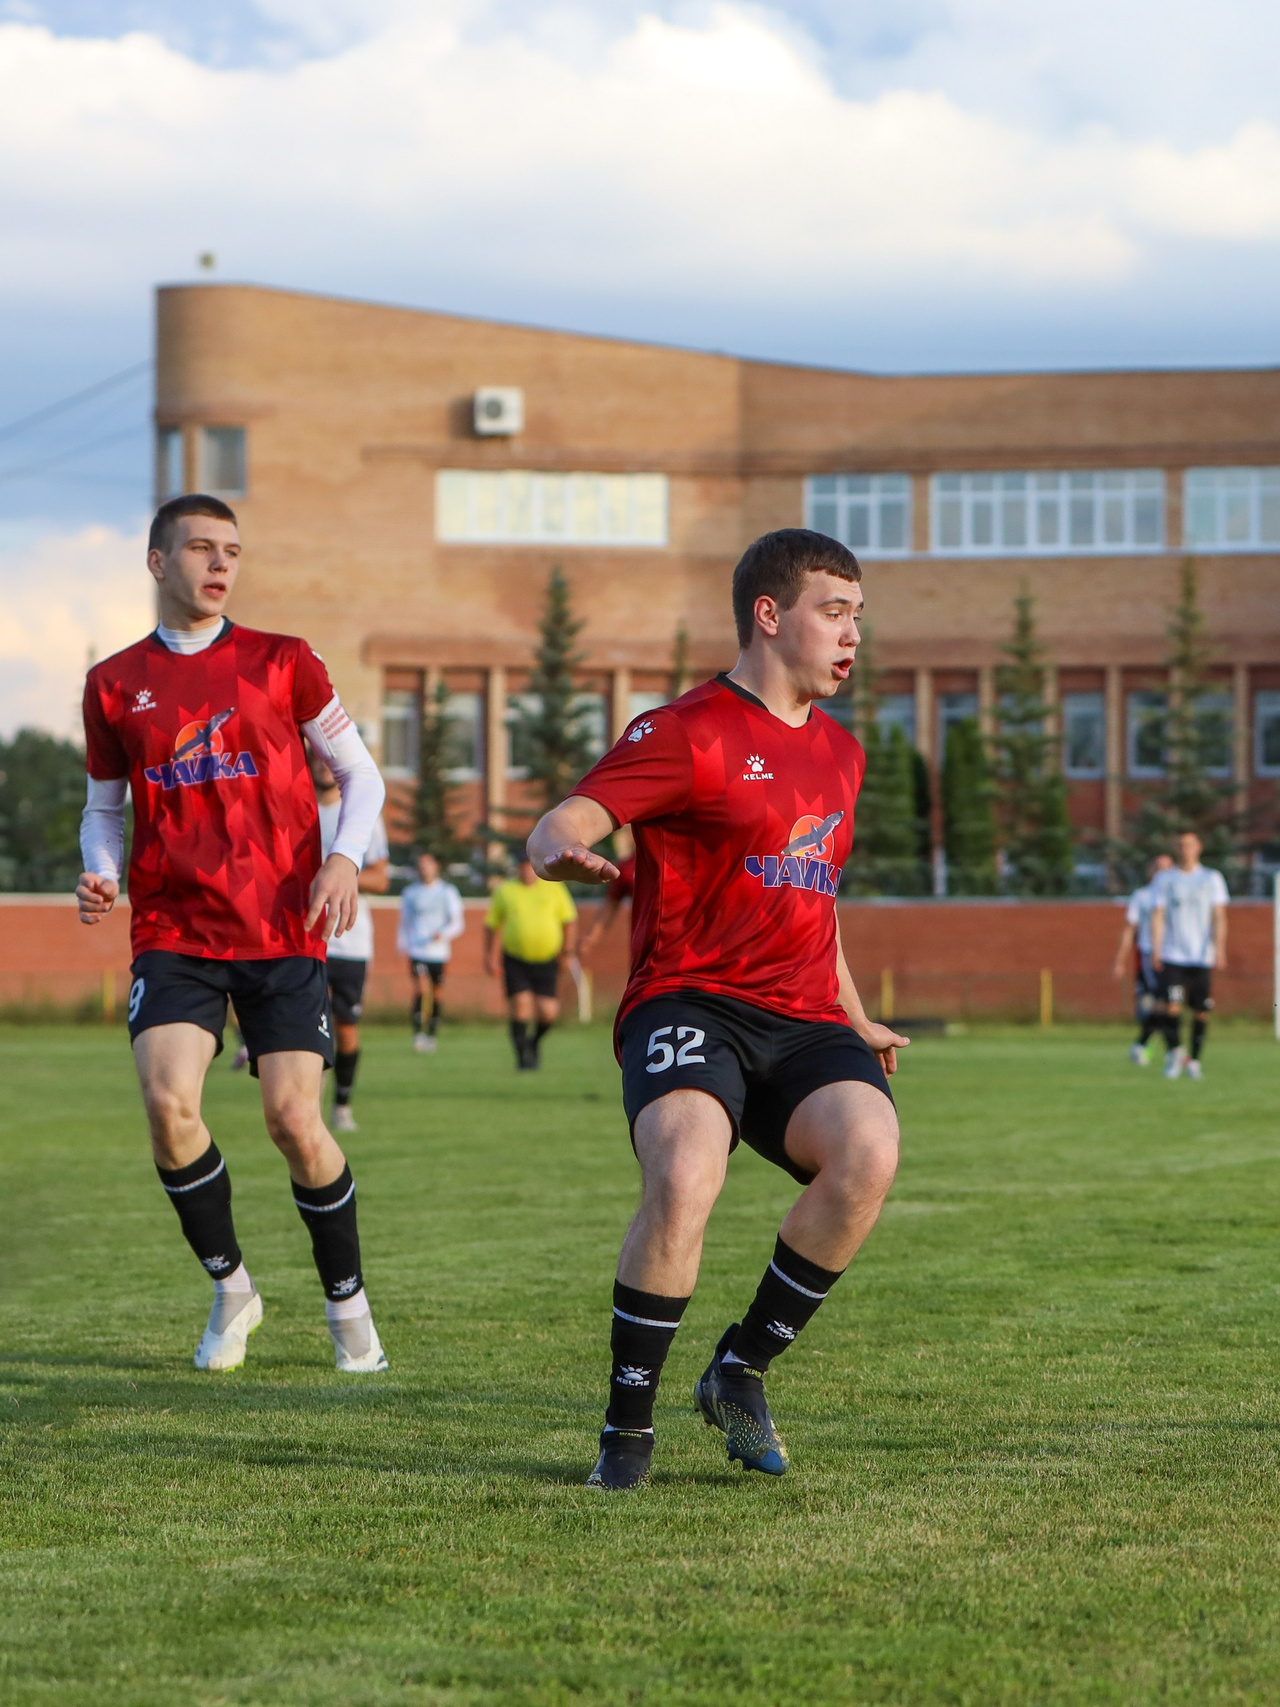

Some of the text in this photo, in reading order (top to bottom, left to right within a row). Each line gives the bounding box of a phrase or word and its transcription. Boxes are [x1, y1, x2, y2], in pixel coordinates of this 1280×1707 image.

[143, 750, 259, 791] ЧАЙКА
[742, 772, 775, 781] KELME
[645, 1025, 706, 1074] 52
[616, 1375, 650, 1387] KELME
